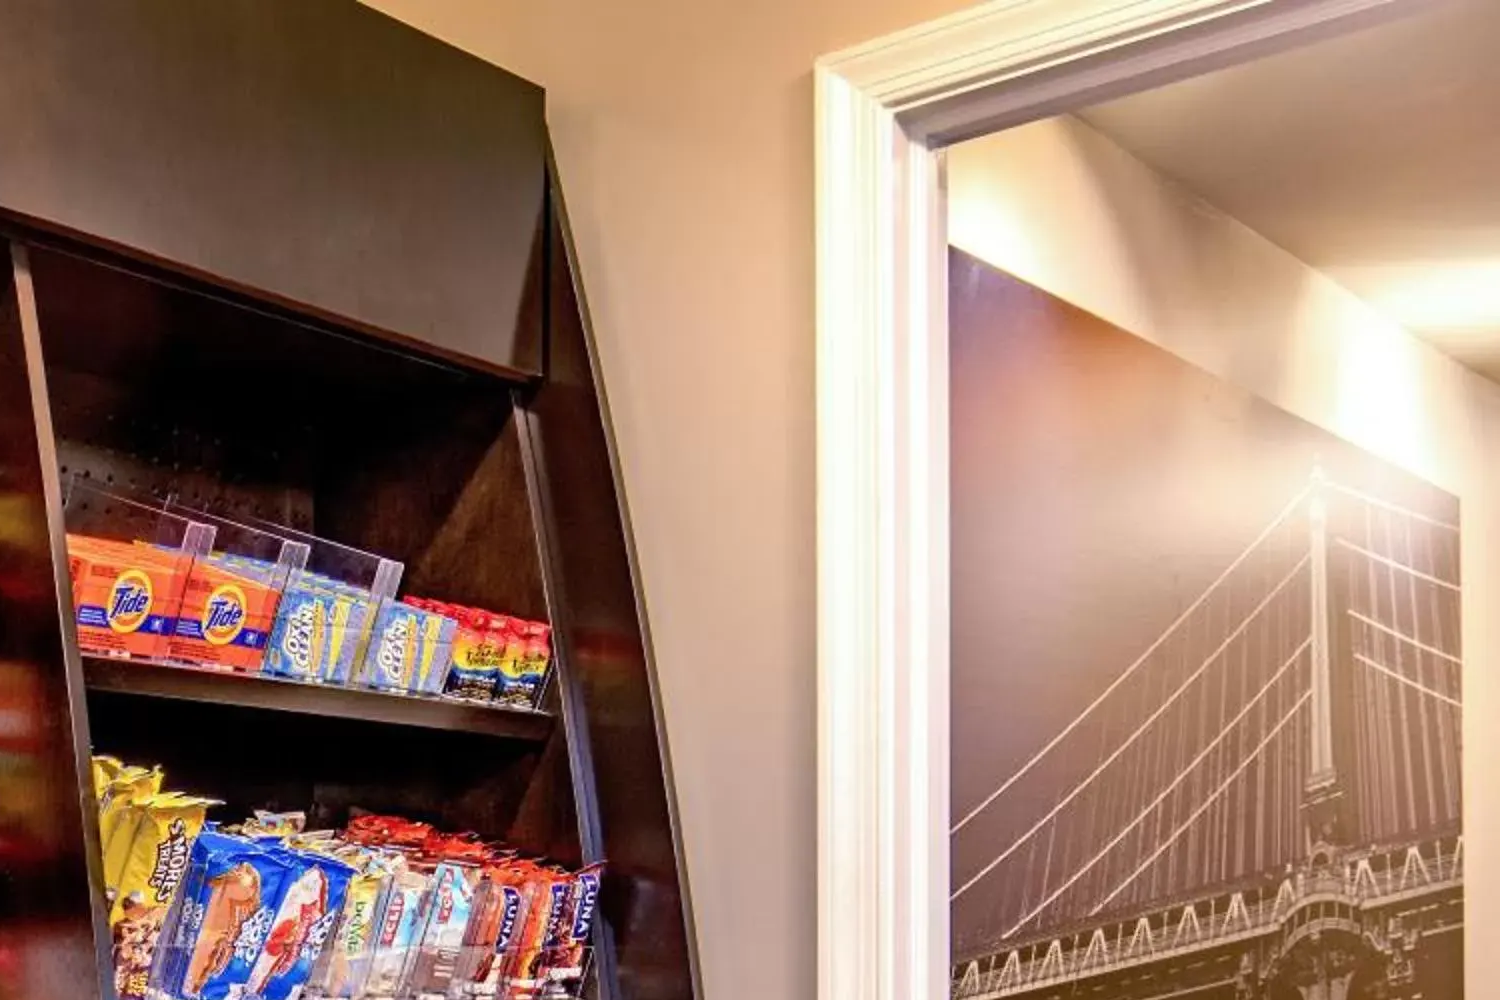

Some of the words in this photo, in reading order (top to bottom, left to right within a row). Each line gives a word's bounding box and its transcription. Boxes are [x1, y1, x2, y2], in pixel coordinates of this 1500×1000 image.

[110, 586, 150, 618] Tide
[206, 600, 243, 631] Tide
[574, 876, 598, 938] LUNA
